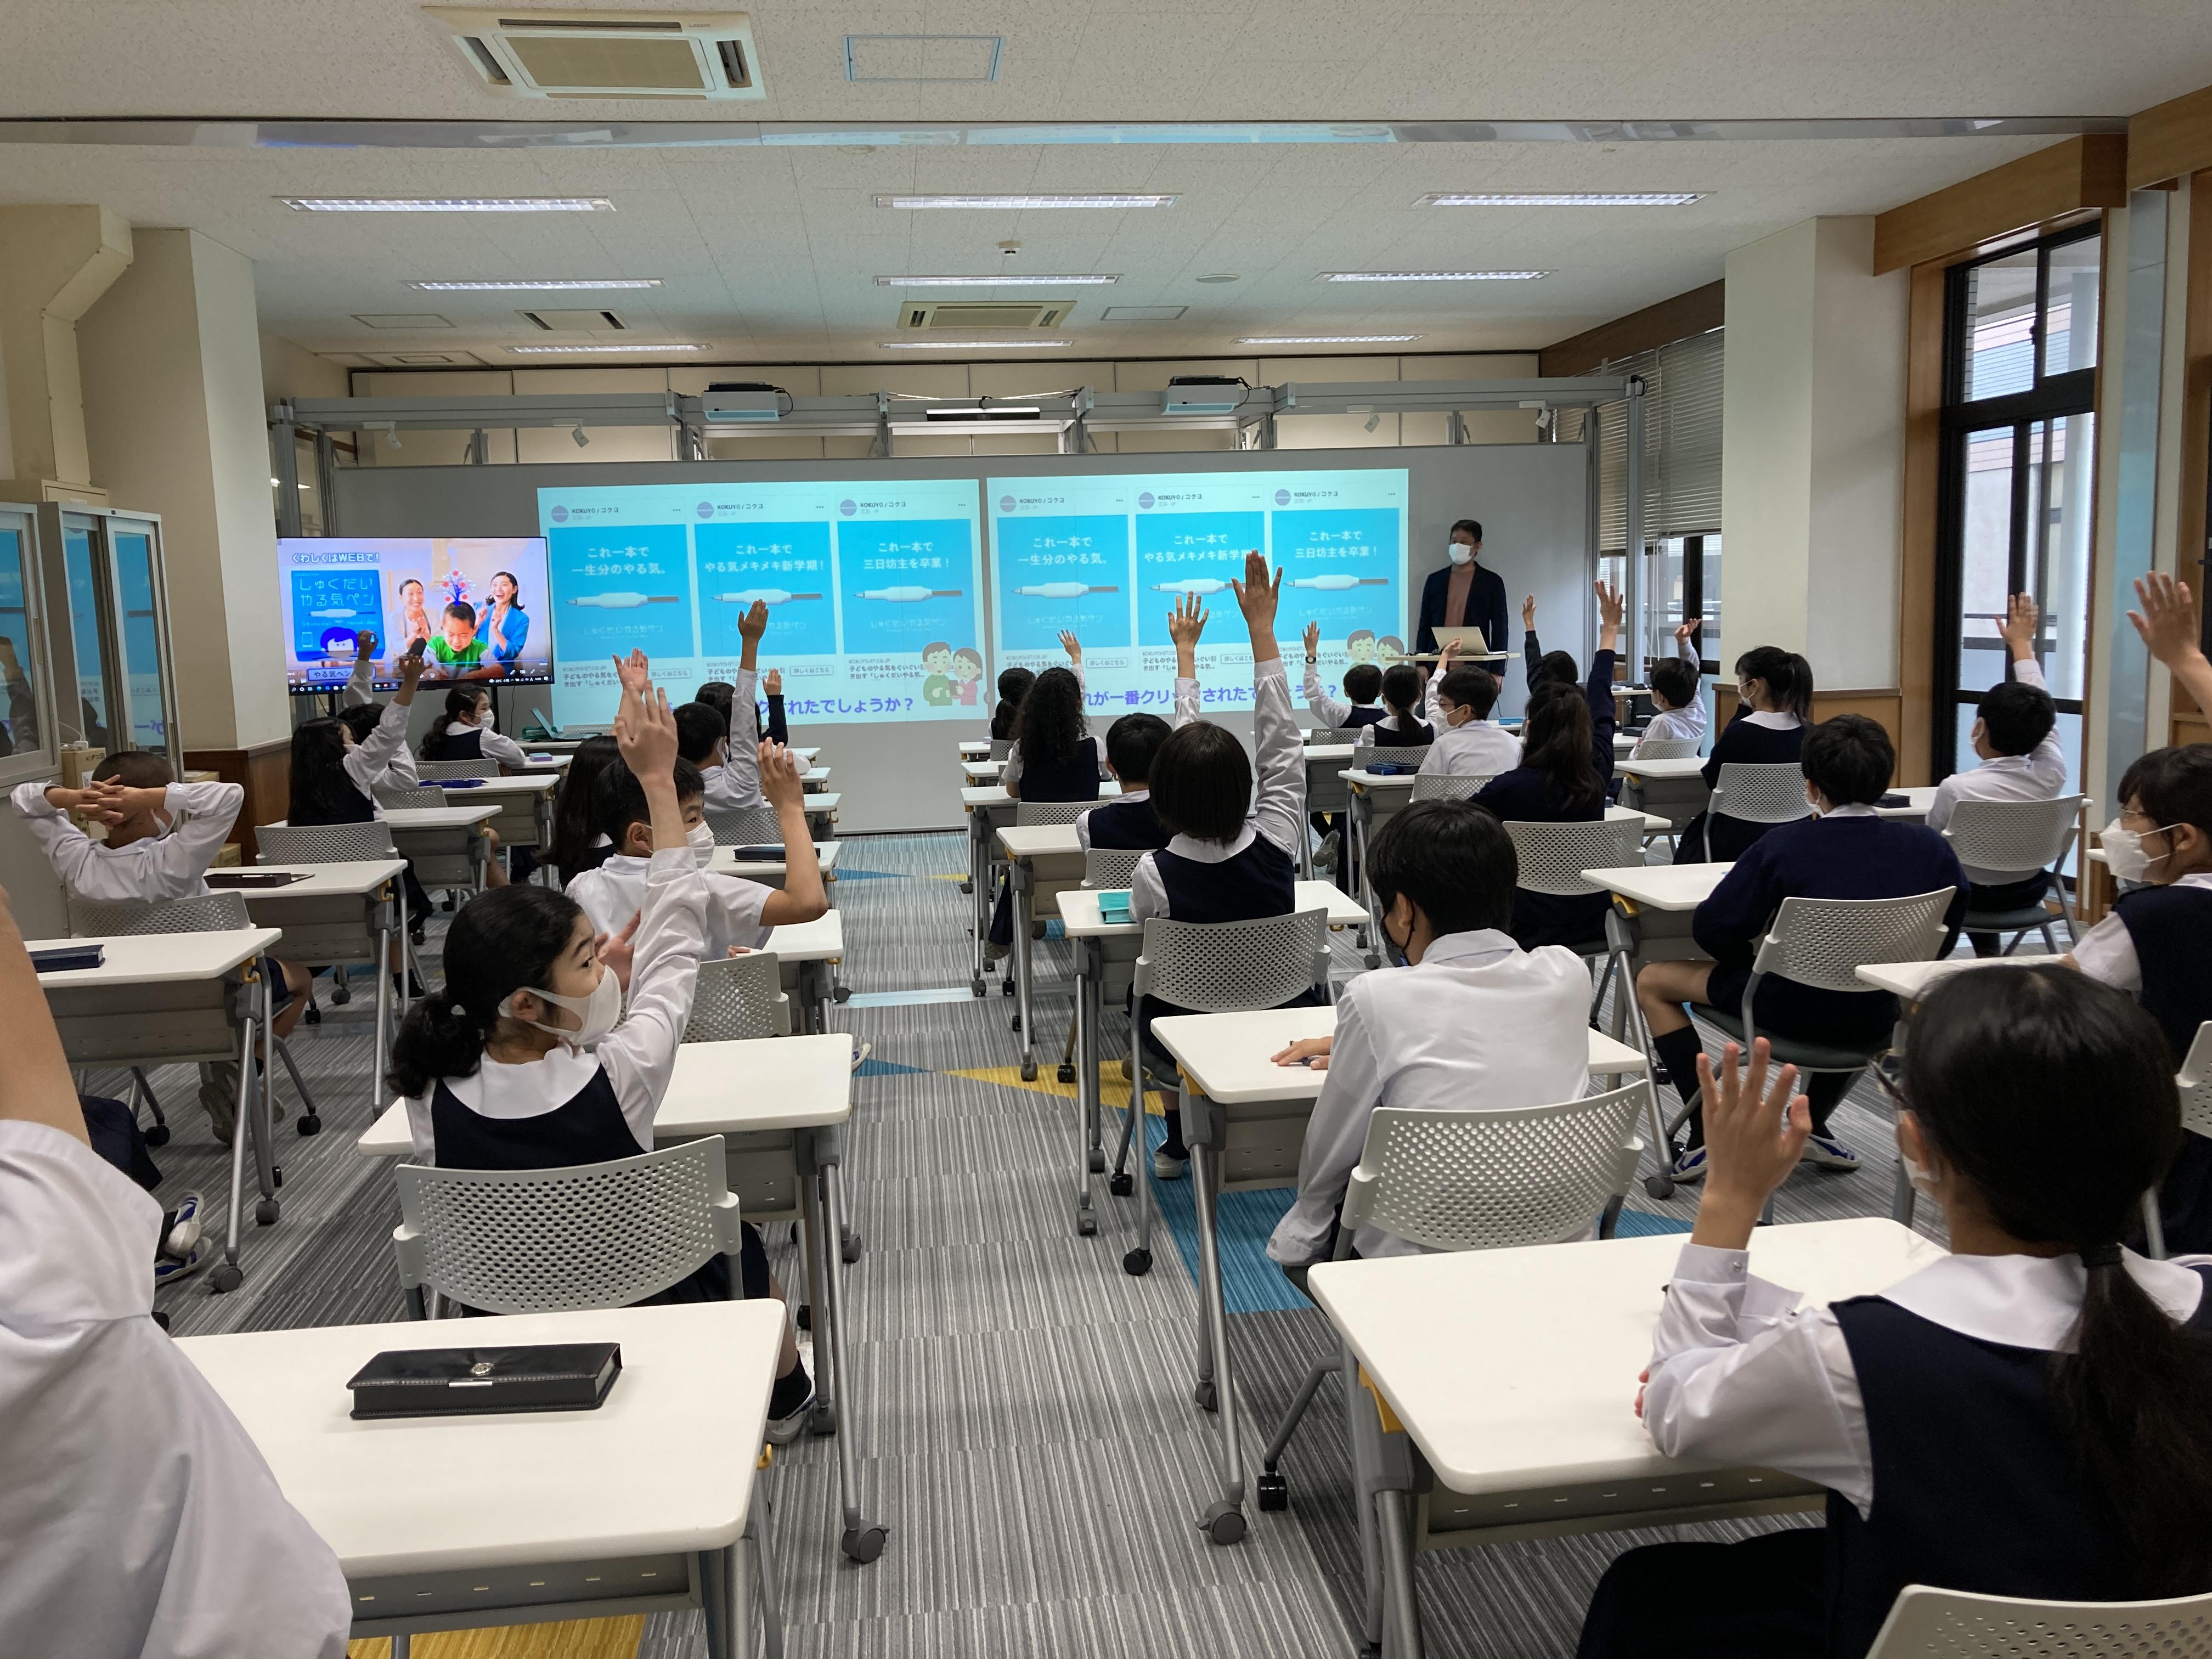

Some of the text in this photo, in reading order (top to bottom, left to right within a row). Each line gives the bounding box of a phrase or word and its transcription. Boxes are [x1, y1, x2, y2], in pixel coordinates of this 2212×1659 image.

[1034, 536, 1092, 549] これ一本で
[1174, 533, 1228, 545] これ一本で
[1310, 531, 1363, 541] これ一本で
[588, 545, 650, 558] これ一本で
[736, 544, 793, 555] これ一本で
[878, 541, 934, 553] これ一本で
[1295, 546, 1377, 558] 三日坊主を卒業!
[863, 557, 949, 570] 三日坊主を卒業!
[1018, 552, 1107, 566] 一生分のやる気。
[572, 562, 665, 576] 一生分のやる気。
[705, 560, 824, 573] やる気メキメキ新学期!
[300, 578, 373, 590] しゅくだい
[300, 593, 374, 606] やる気ペン
